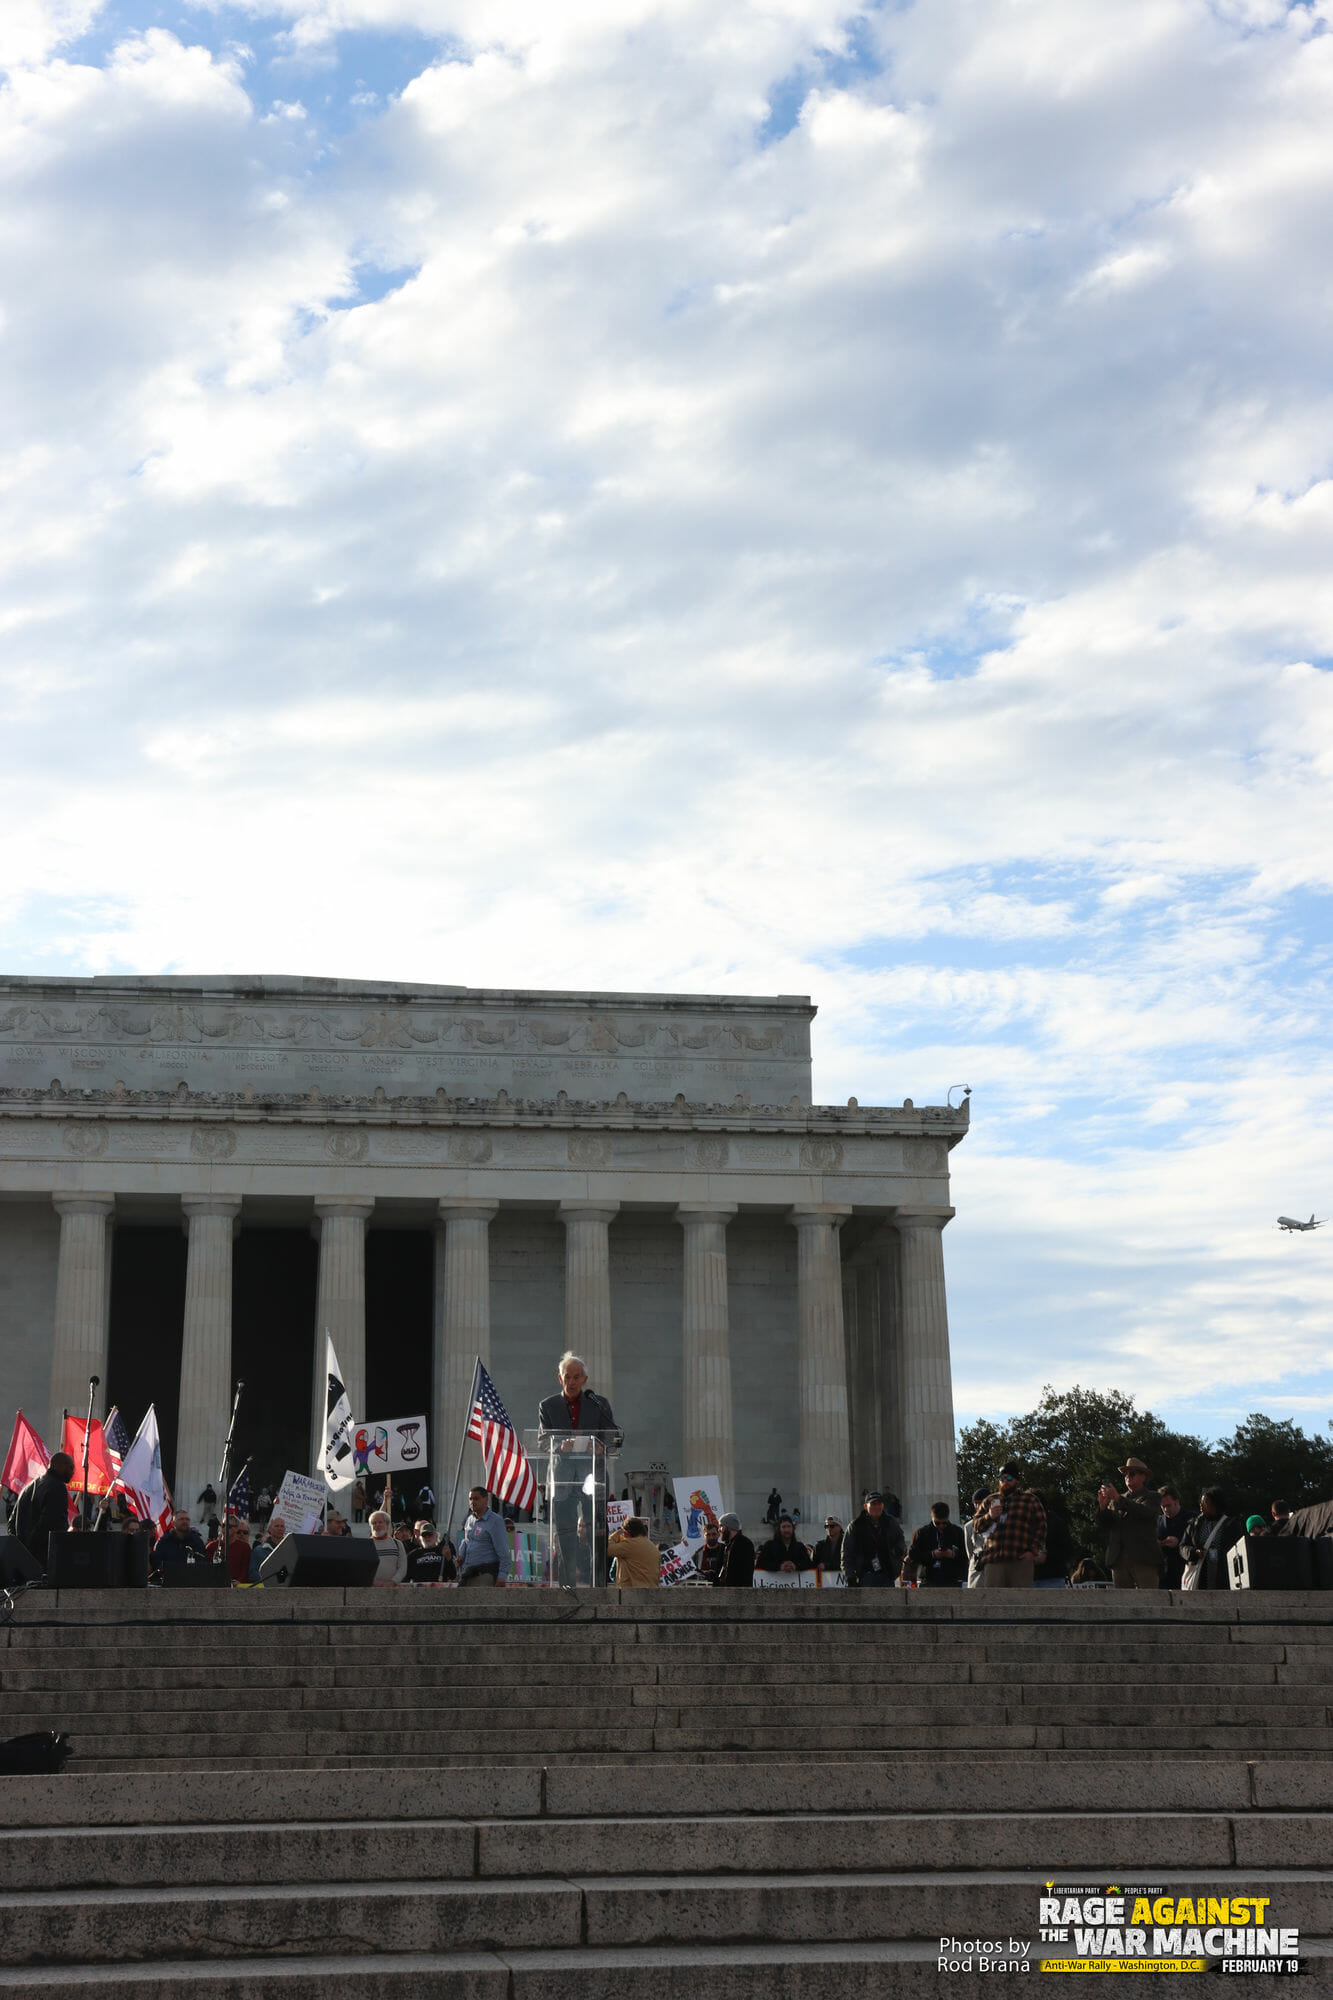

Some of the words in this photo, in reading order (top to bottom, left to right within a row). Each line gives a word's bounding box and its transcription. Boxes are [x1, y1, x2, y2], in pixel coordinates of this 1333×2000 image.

[57, 1048, 128, 1058] WISCONSIN
[139, 1050, 209, 1061] CALIFORNIA
[222, 1051, 289, 1063] MINNESOTA
[303, 1054, 350, 1064] OREGON
[361, 1056, 405, 1066] KANSAS
[415, 1056, 444, 1067] WEST
[448, 1057, 499, 1069] VIRGINIA
[633, 1062, 695, 1073] COLORADO
